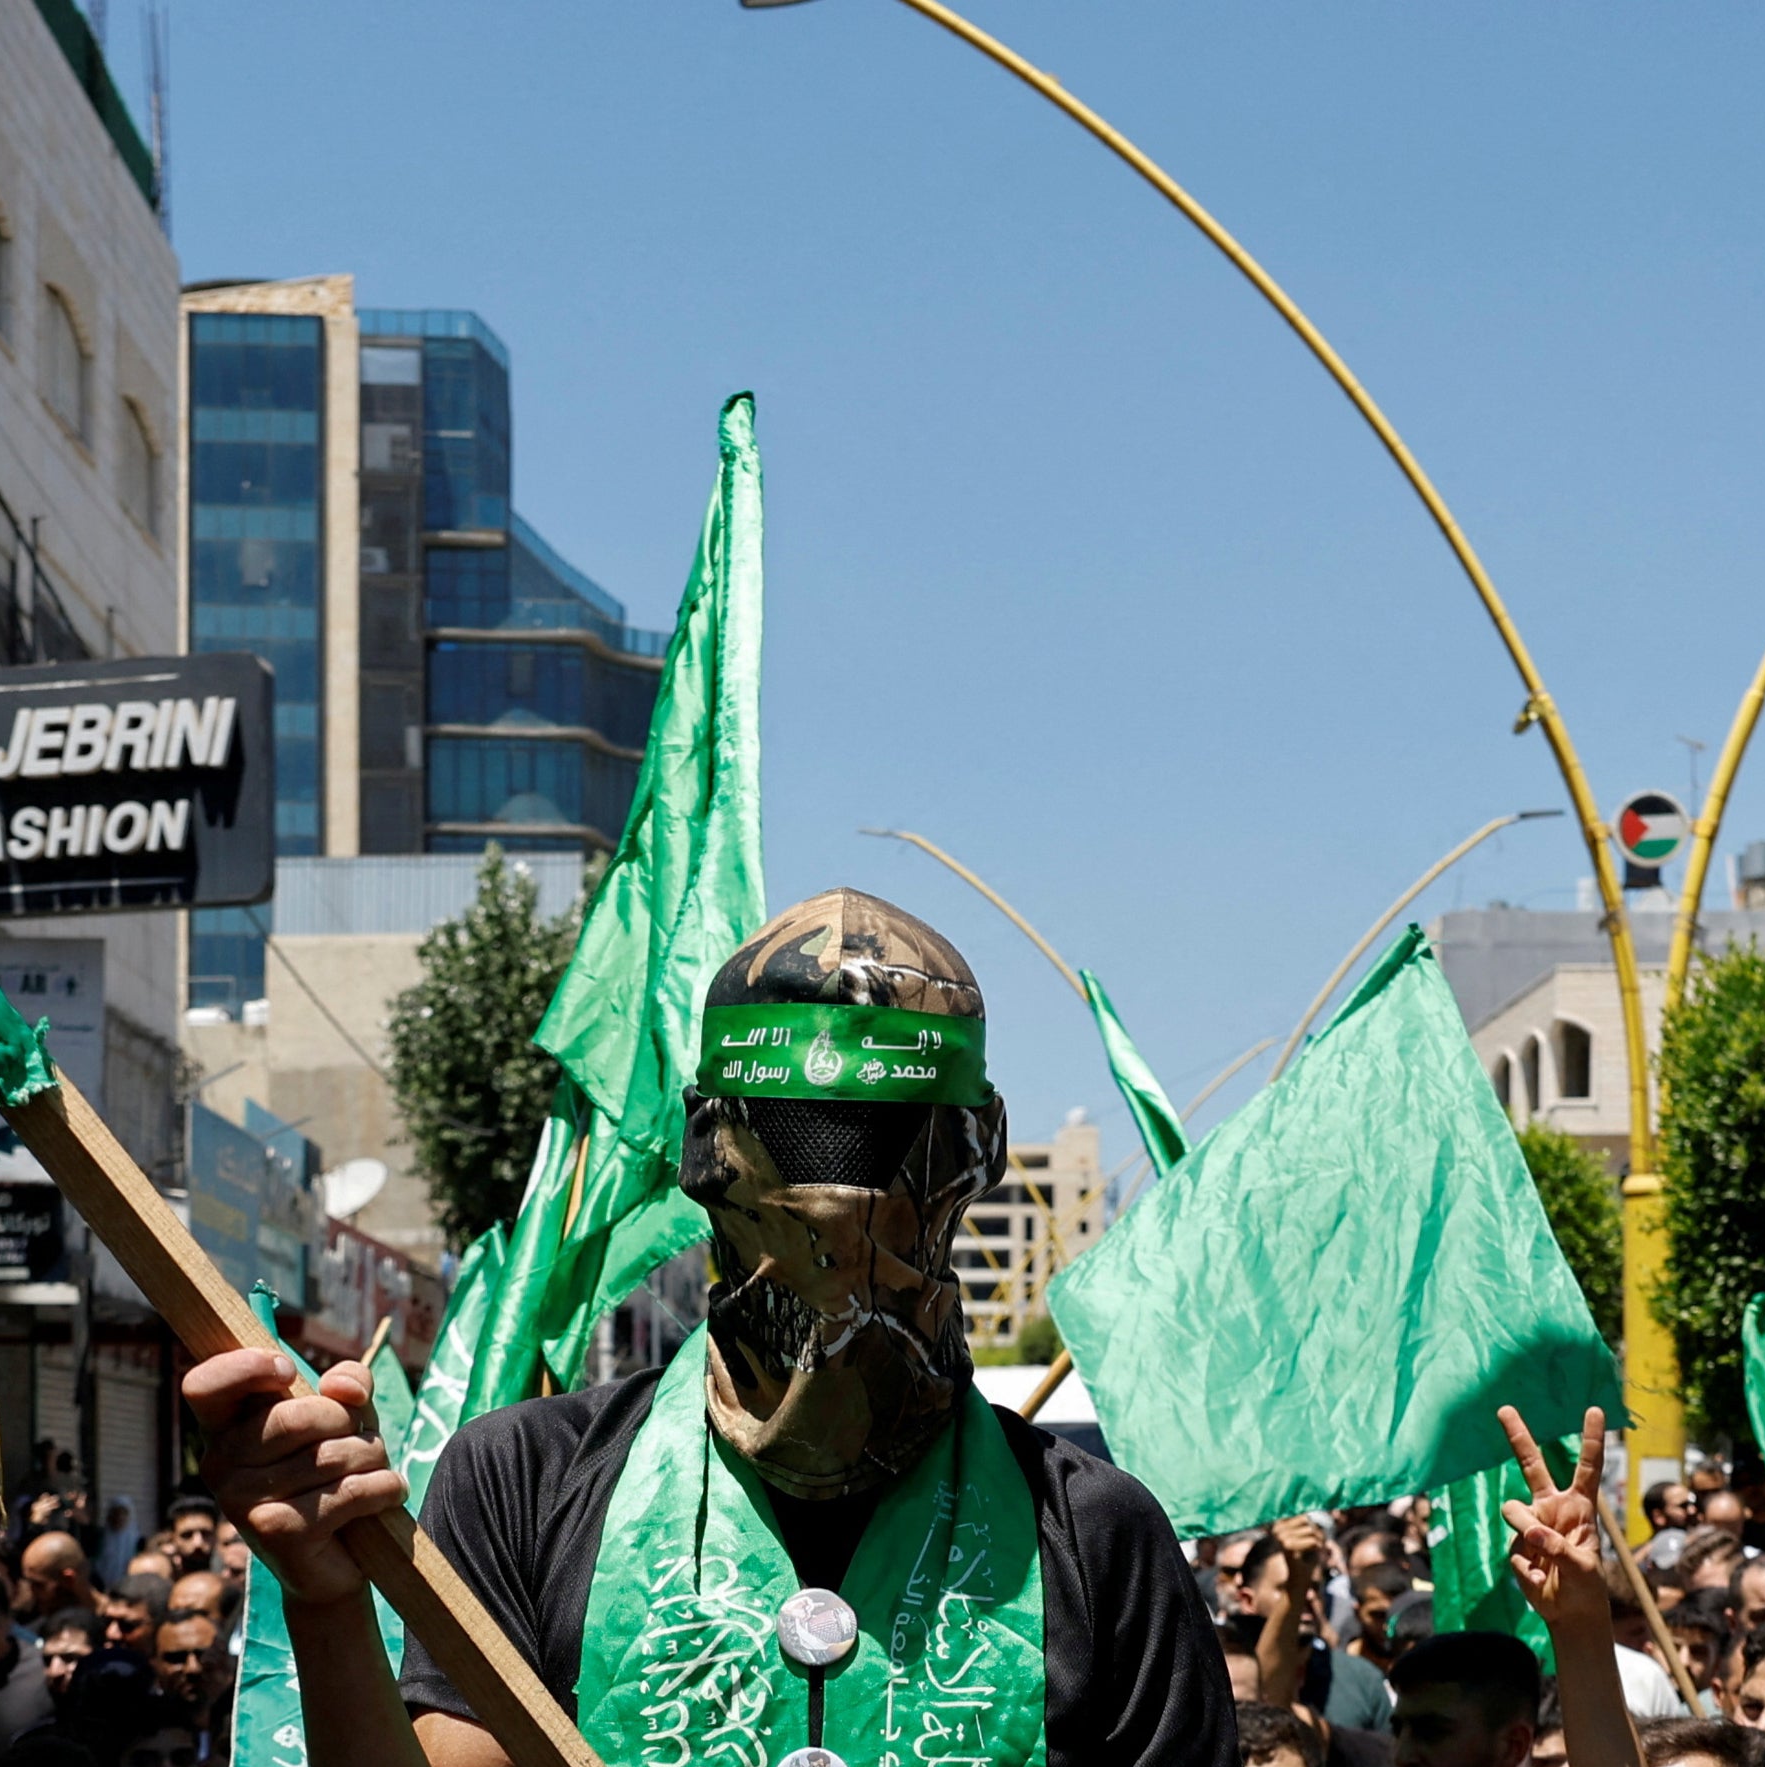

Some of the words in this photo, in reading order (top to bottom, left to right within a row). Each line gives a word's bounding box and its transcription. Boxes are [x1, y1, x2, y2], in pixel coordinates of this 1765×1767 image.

[721, 1027, 765, 1047] الله
[860, 1029, 928, 1056] إله
[932, 1030, 943, 1049] لا
[722, 1060, 742, 1079] الله
[744, 1061, 791, 1084] رسول
[890, 1064, 937, 1080] محمد
[879, 1612, 917, 1742] جامعة
